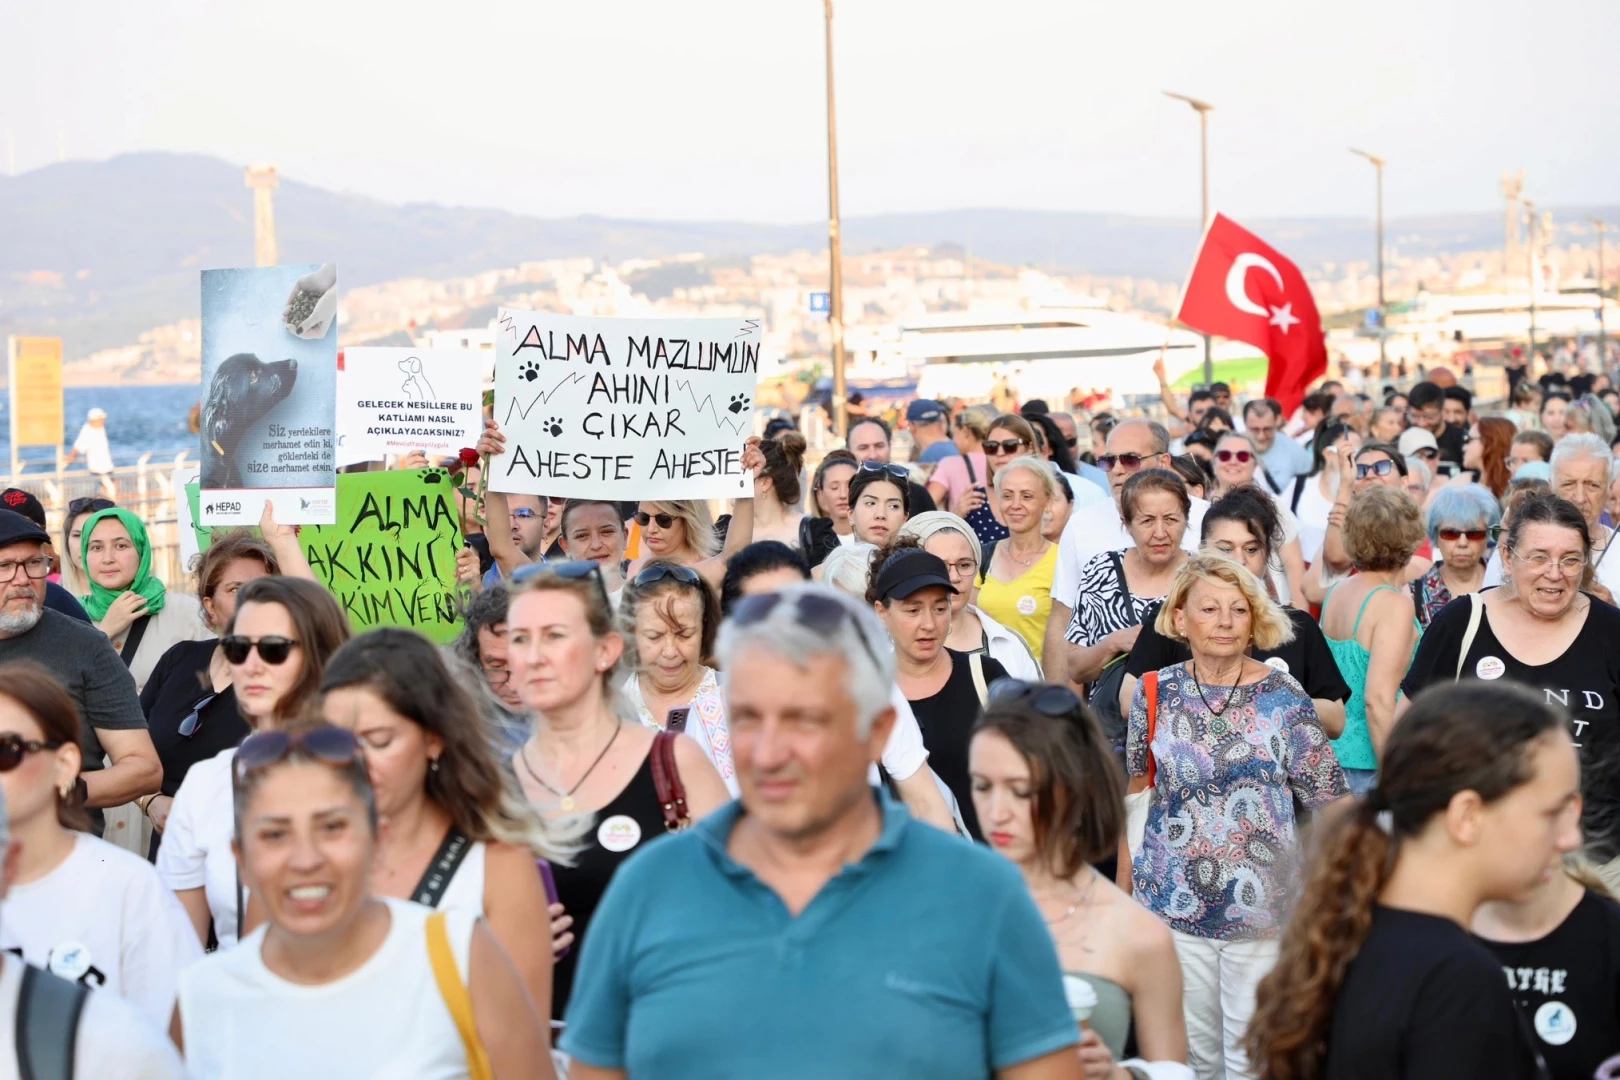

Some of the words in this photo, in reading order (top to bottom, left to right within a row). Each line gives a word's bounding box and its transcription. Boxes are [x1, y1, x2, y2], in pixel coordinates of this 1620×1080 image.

[512, 325, 611, 366] ALMA
[626, 335, 760, 374] MAZLUMUN
[587, 371, 669, 405] AHINI
[357, 400, 404, 408] GELECEK
[407, 400, 457, 410] NESİLLERE
[460, 403, 473, 411] BU
[378, 413, 425, 422] KATLİAMI
[428, 415, 455, 424] NASIL
[582, 408, 686, 440] ÇIKAR
[268, 424, 286, 437] Siz
[288, 427, 331, 439] yerdekilere
[367, 427, 465, 437] AÇIKLAYACAKSINIZ?
[262, 440, 301, 450] merhamet
[303, 439, 321, 449] edin
[278, 452, 319, 462] göklerdeki
[321, 451, 331, 460] de
[507, 444, 634, 480] AHESTE
[247, 460, 269, 473] size
[271, 463, 309, 473] merhamet
[312, 463, 333, 472] etsin.
[215, 501, 241, 511] HEPAD
[349, 491, 458, 540] ALMA
[308, 533, 445, 588] AKKINI
